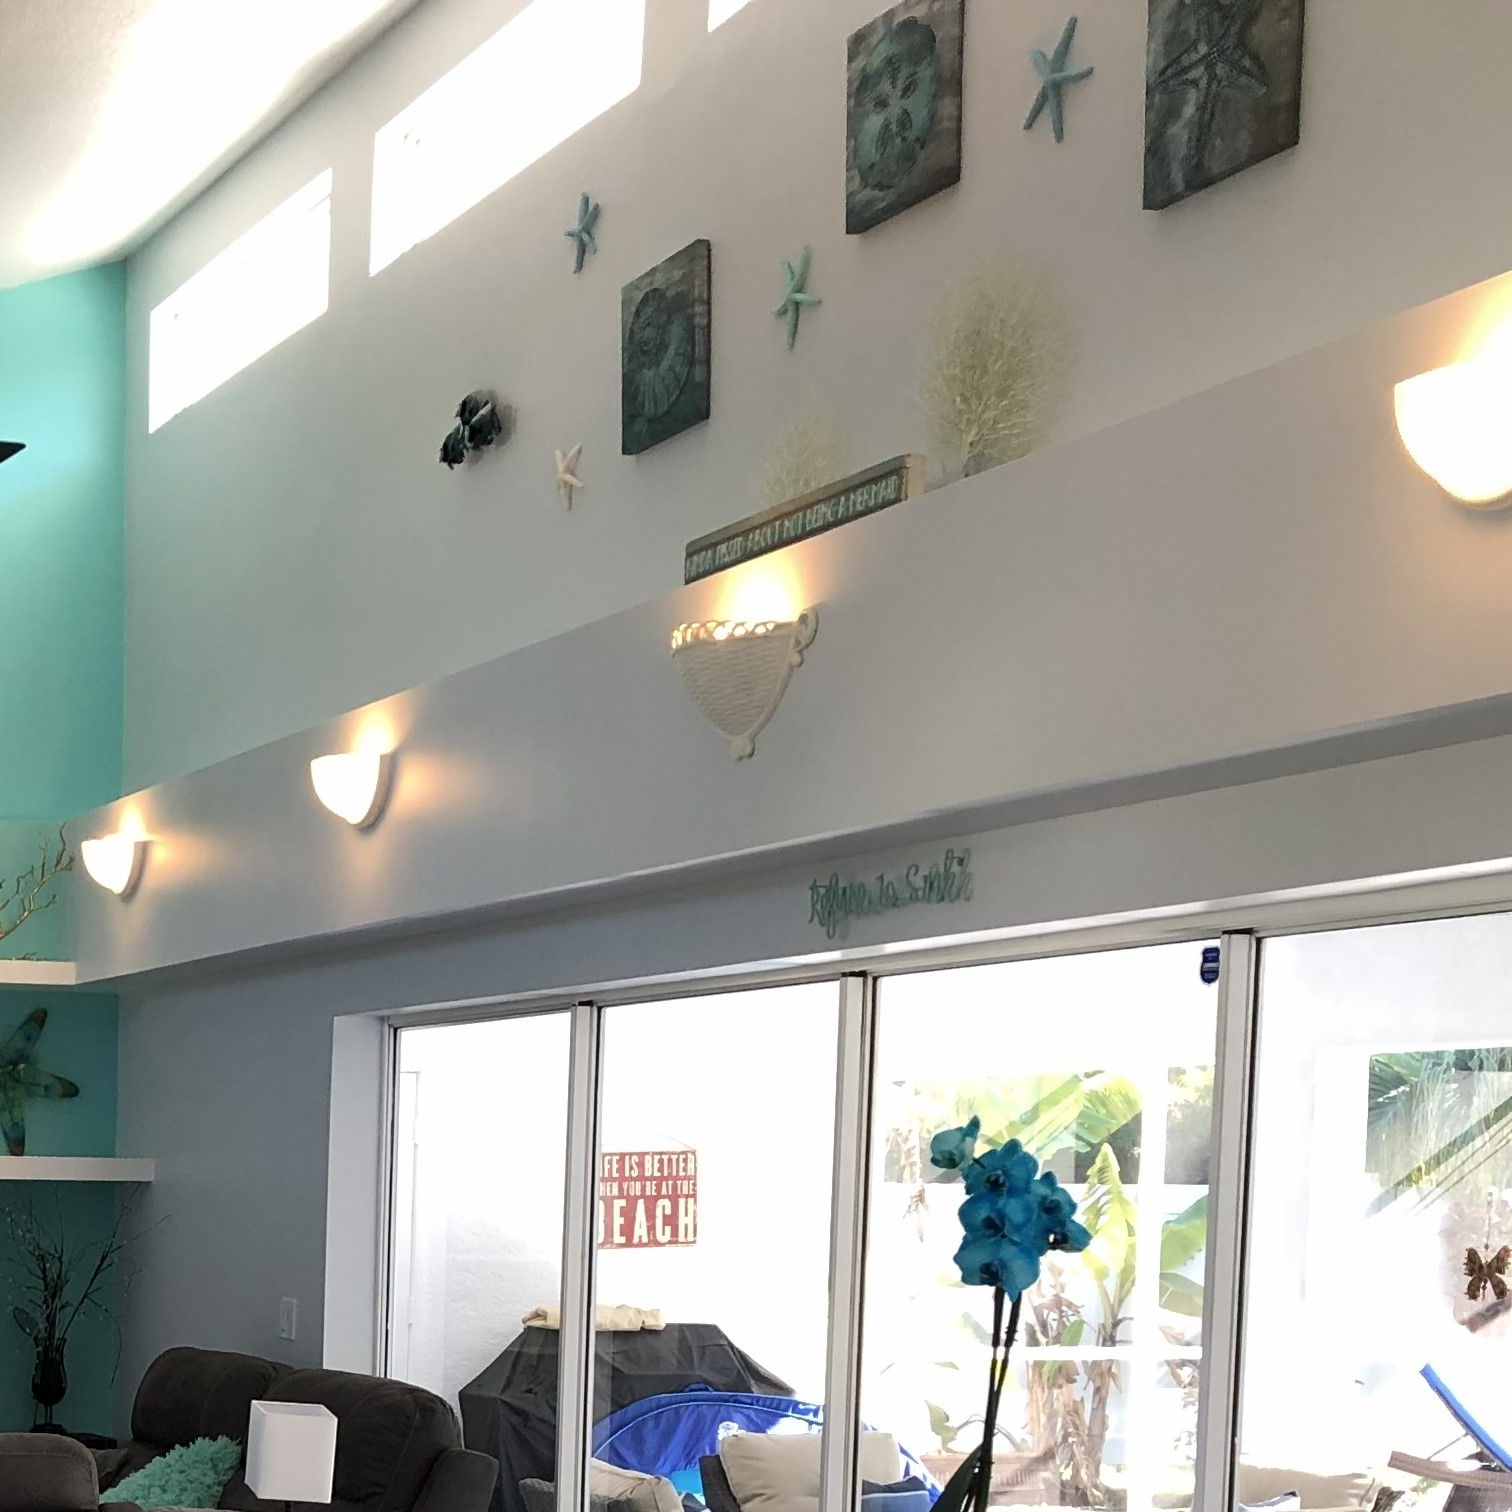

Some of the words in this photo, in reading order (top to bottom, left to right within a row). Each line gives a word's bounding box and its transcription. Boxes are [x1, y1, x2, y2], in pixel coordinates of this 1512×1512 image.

[747, 519, 782, 553] ABOUT
[783, 512, 802, 541] NOT
[850, 475, 899, 516] MERMAID
[600, 1155, 619, 1178] FE
[625, 1155, 639, 1178] IS
[644, 1153, 695, 1177] BETTER
[600, 1181, 619, 1197] HEN
[623, 1180, 657, 1196] YOU'RE
[661, 1180, 673, 1196] AT
[677, 1180, 695, 1195] THE
